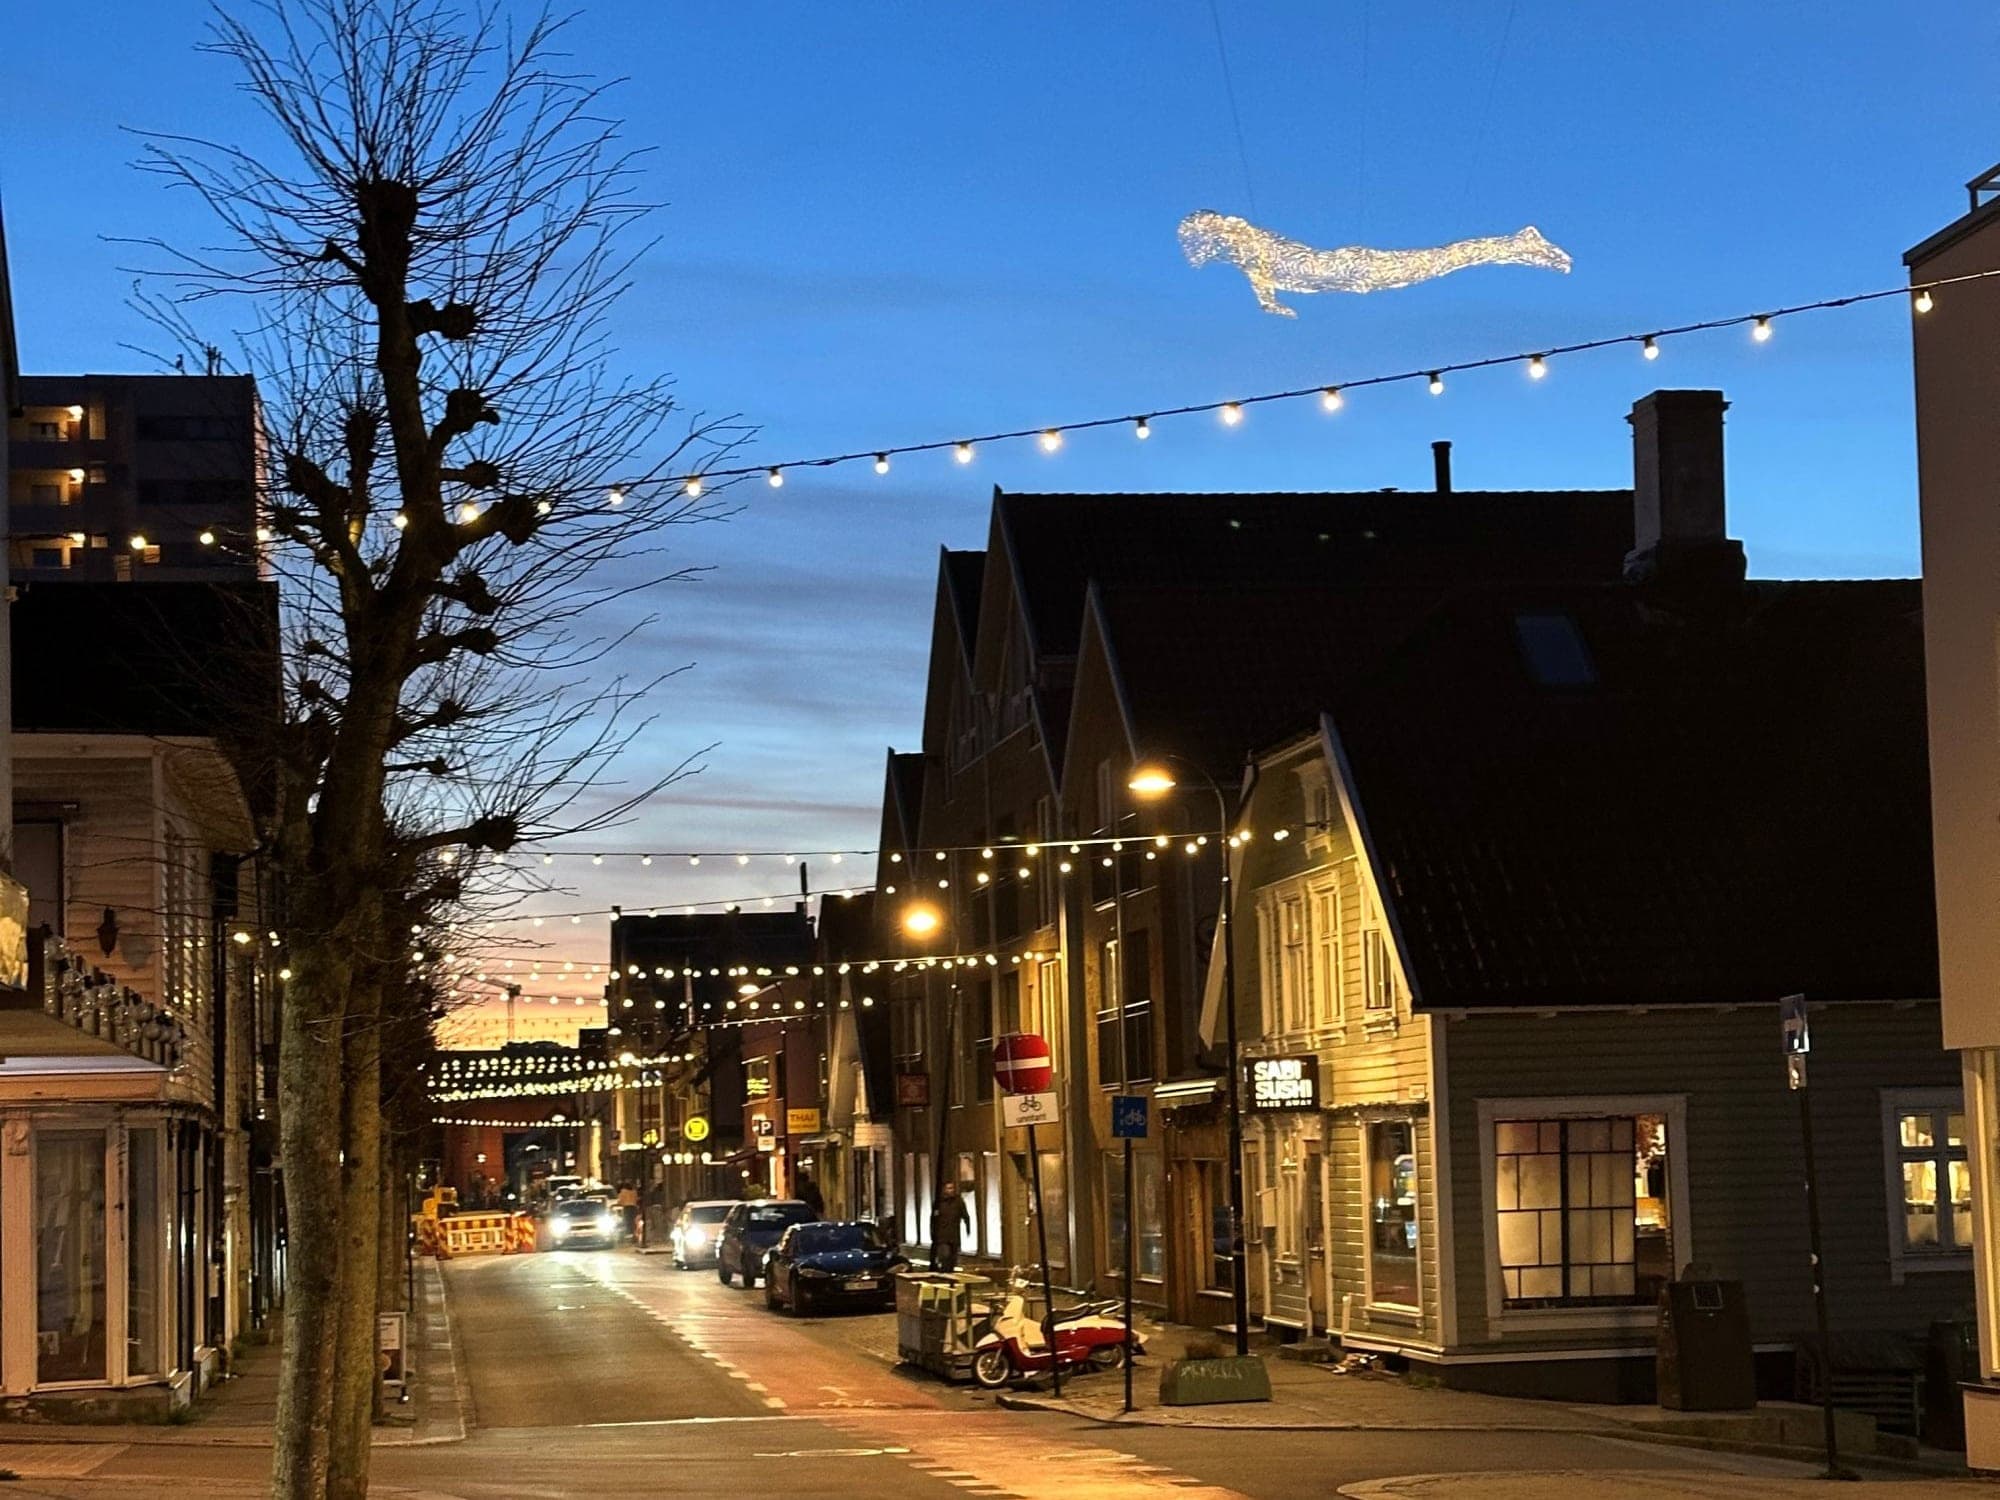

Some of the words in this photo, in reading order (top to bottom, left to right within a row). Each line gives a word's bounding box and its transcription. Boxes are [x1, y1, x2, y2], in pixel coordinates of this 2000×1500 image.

[1254, 1060, 1301, 1080] SABI
[1255, 1080, 1312, 1100] SUSHI
[1256, 1100, 1280, 1108] TAKE
[1285, 1099, 1312, 1107] AWAY
[761, 1121, 772, 1135] P
